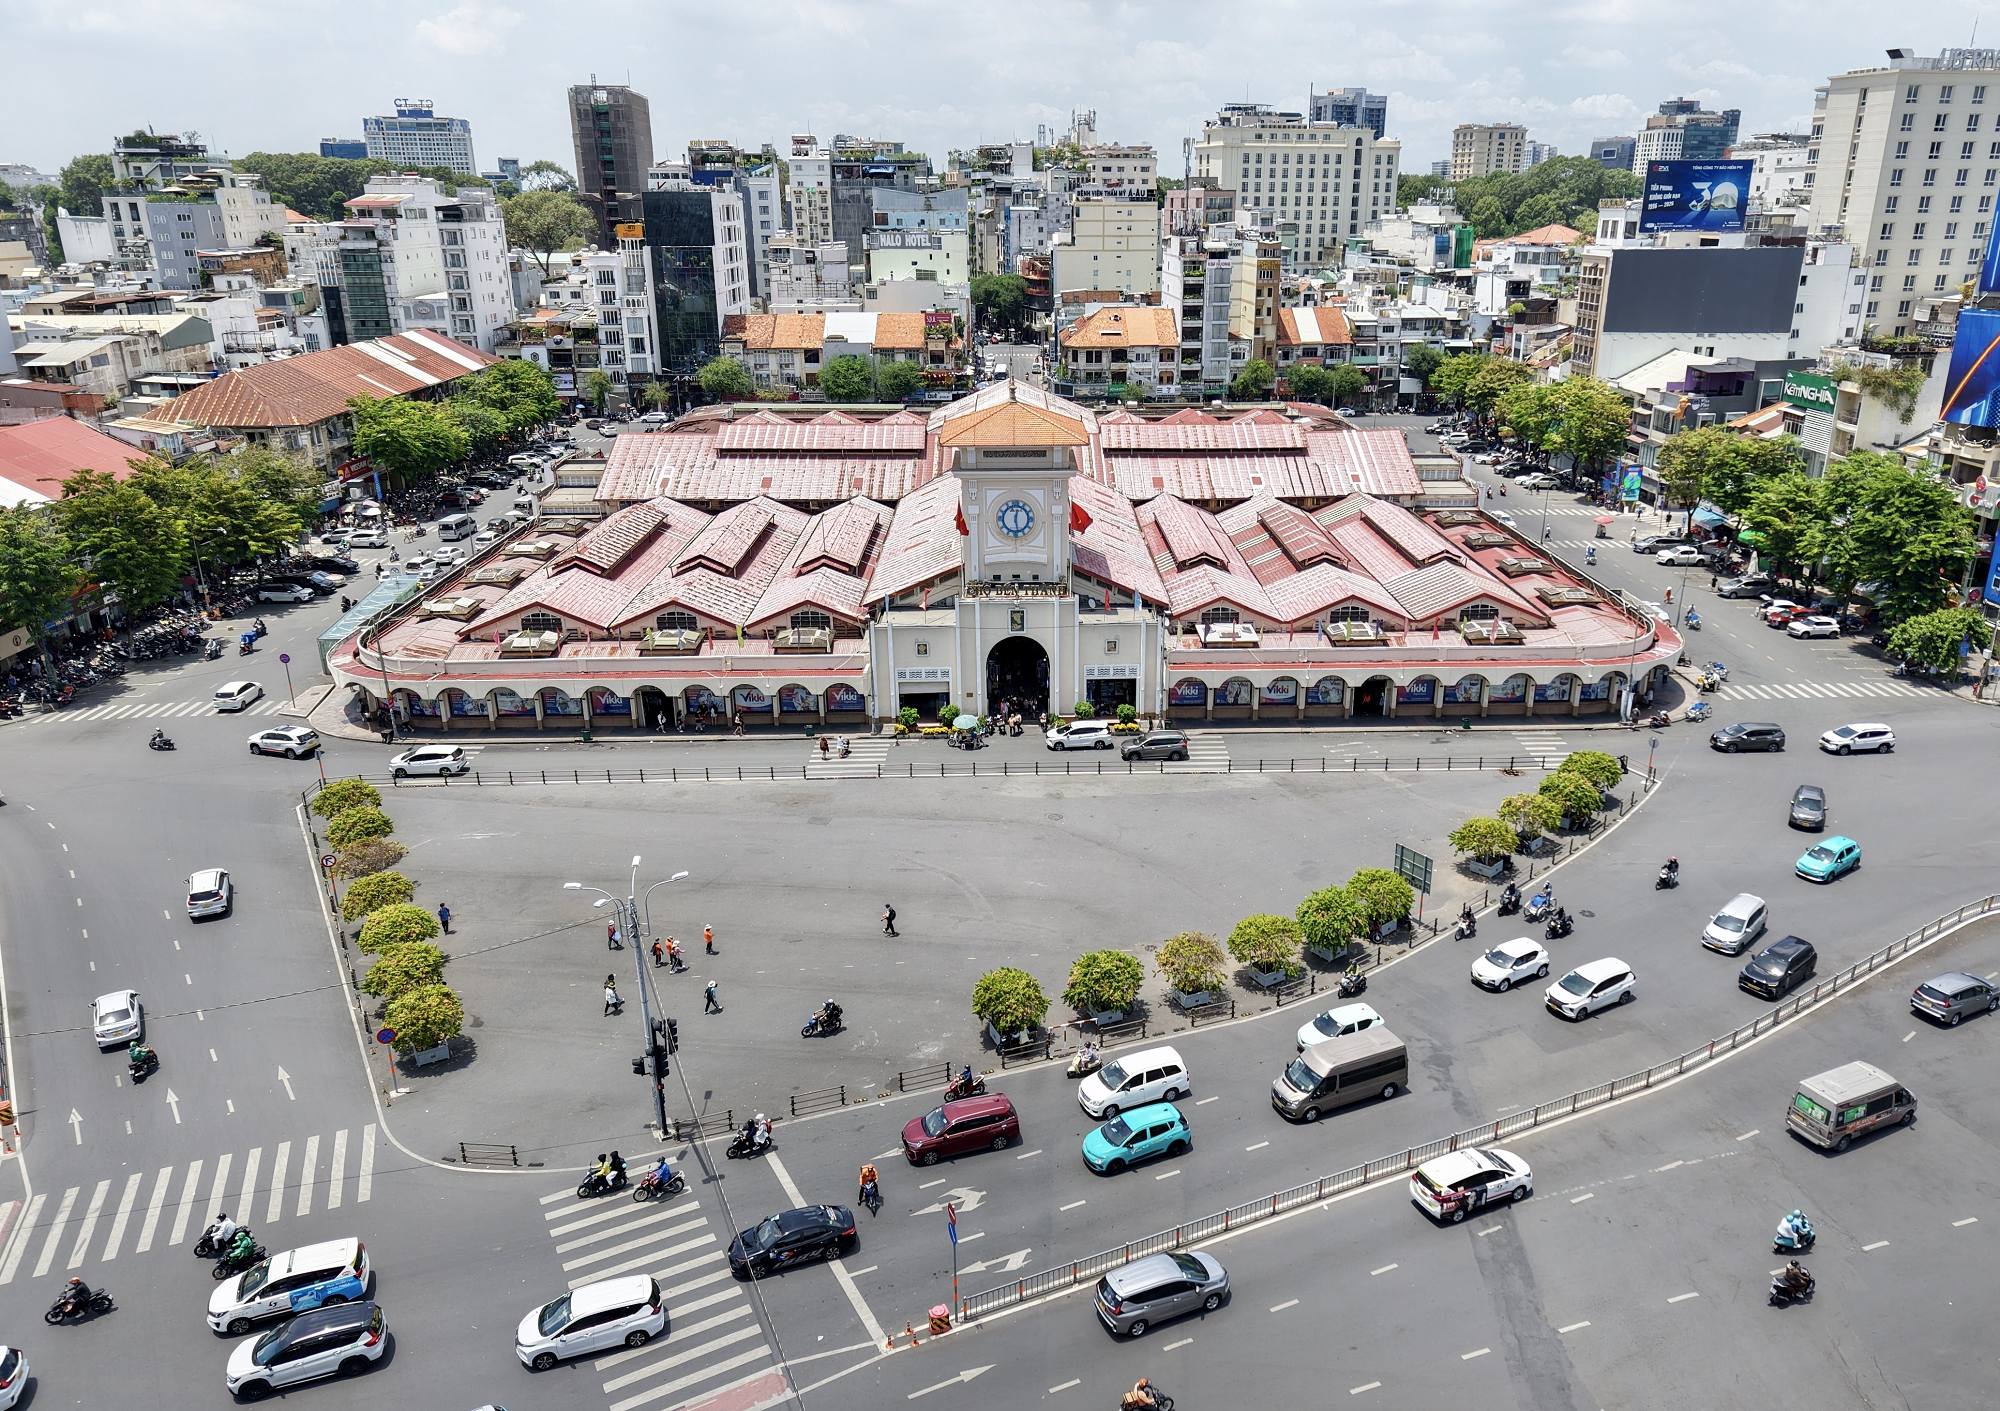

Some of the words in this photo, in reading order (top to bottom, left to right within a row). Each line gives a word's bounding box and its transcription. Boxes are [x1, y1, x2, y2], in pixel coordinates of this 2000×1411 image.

[880, 235, 901, 246] HALO
[905, 235, 931, 246] HOTEL
[350, 460, 367, 472] VISSAN
[1174, 682, 1199, 695] Vikki
[1267, 681, 1289, 694] Vikki
[1405, 680, 1427, 693] Vikki
[597, 690, 623, 704] Vikki
[739, 689, 765, 703] Vikki
[832, 688, 857, 702] Vikki
